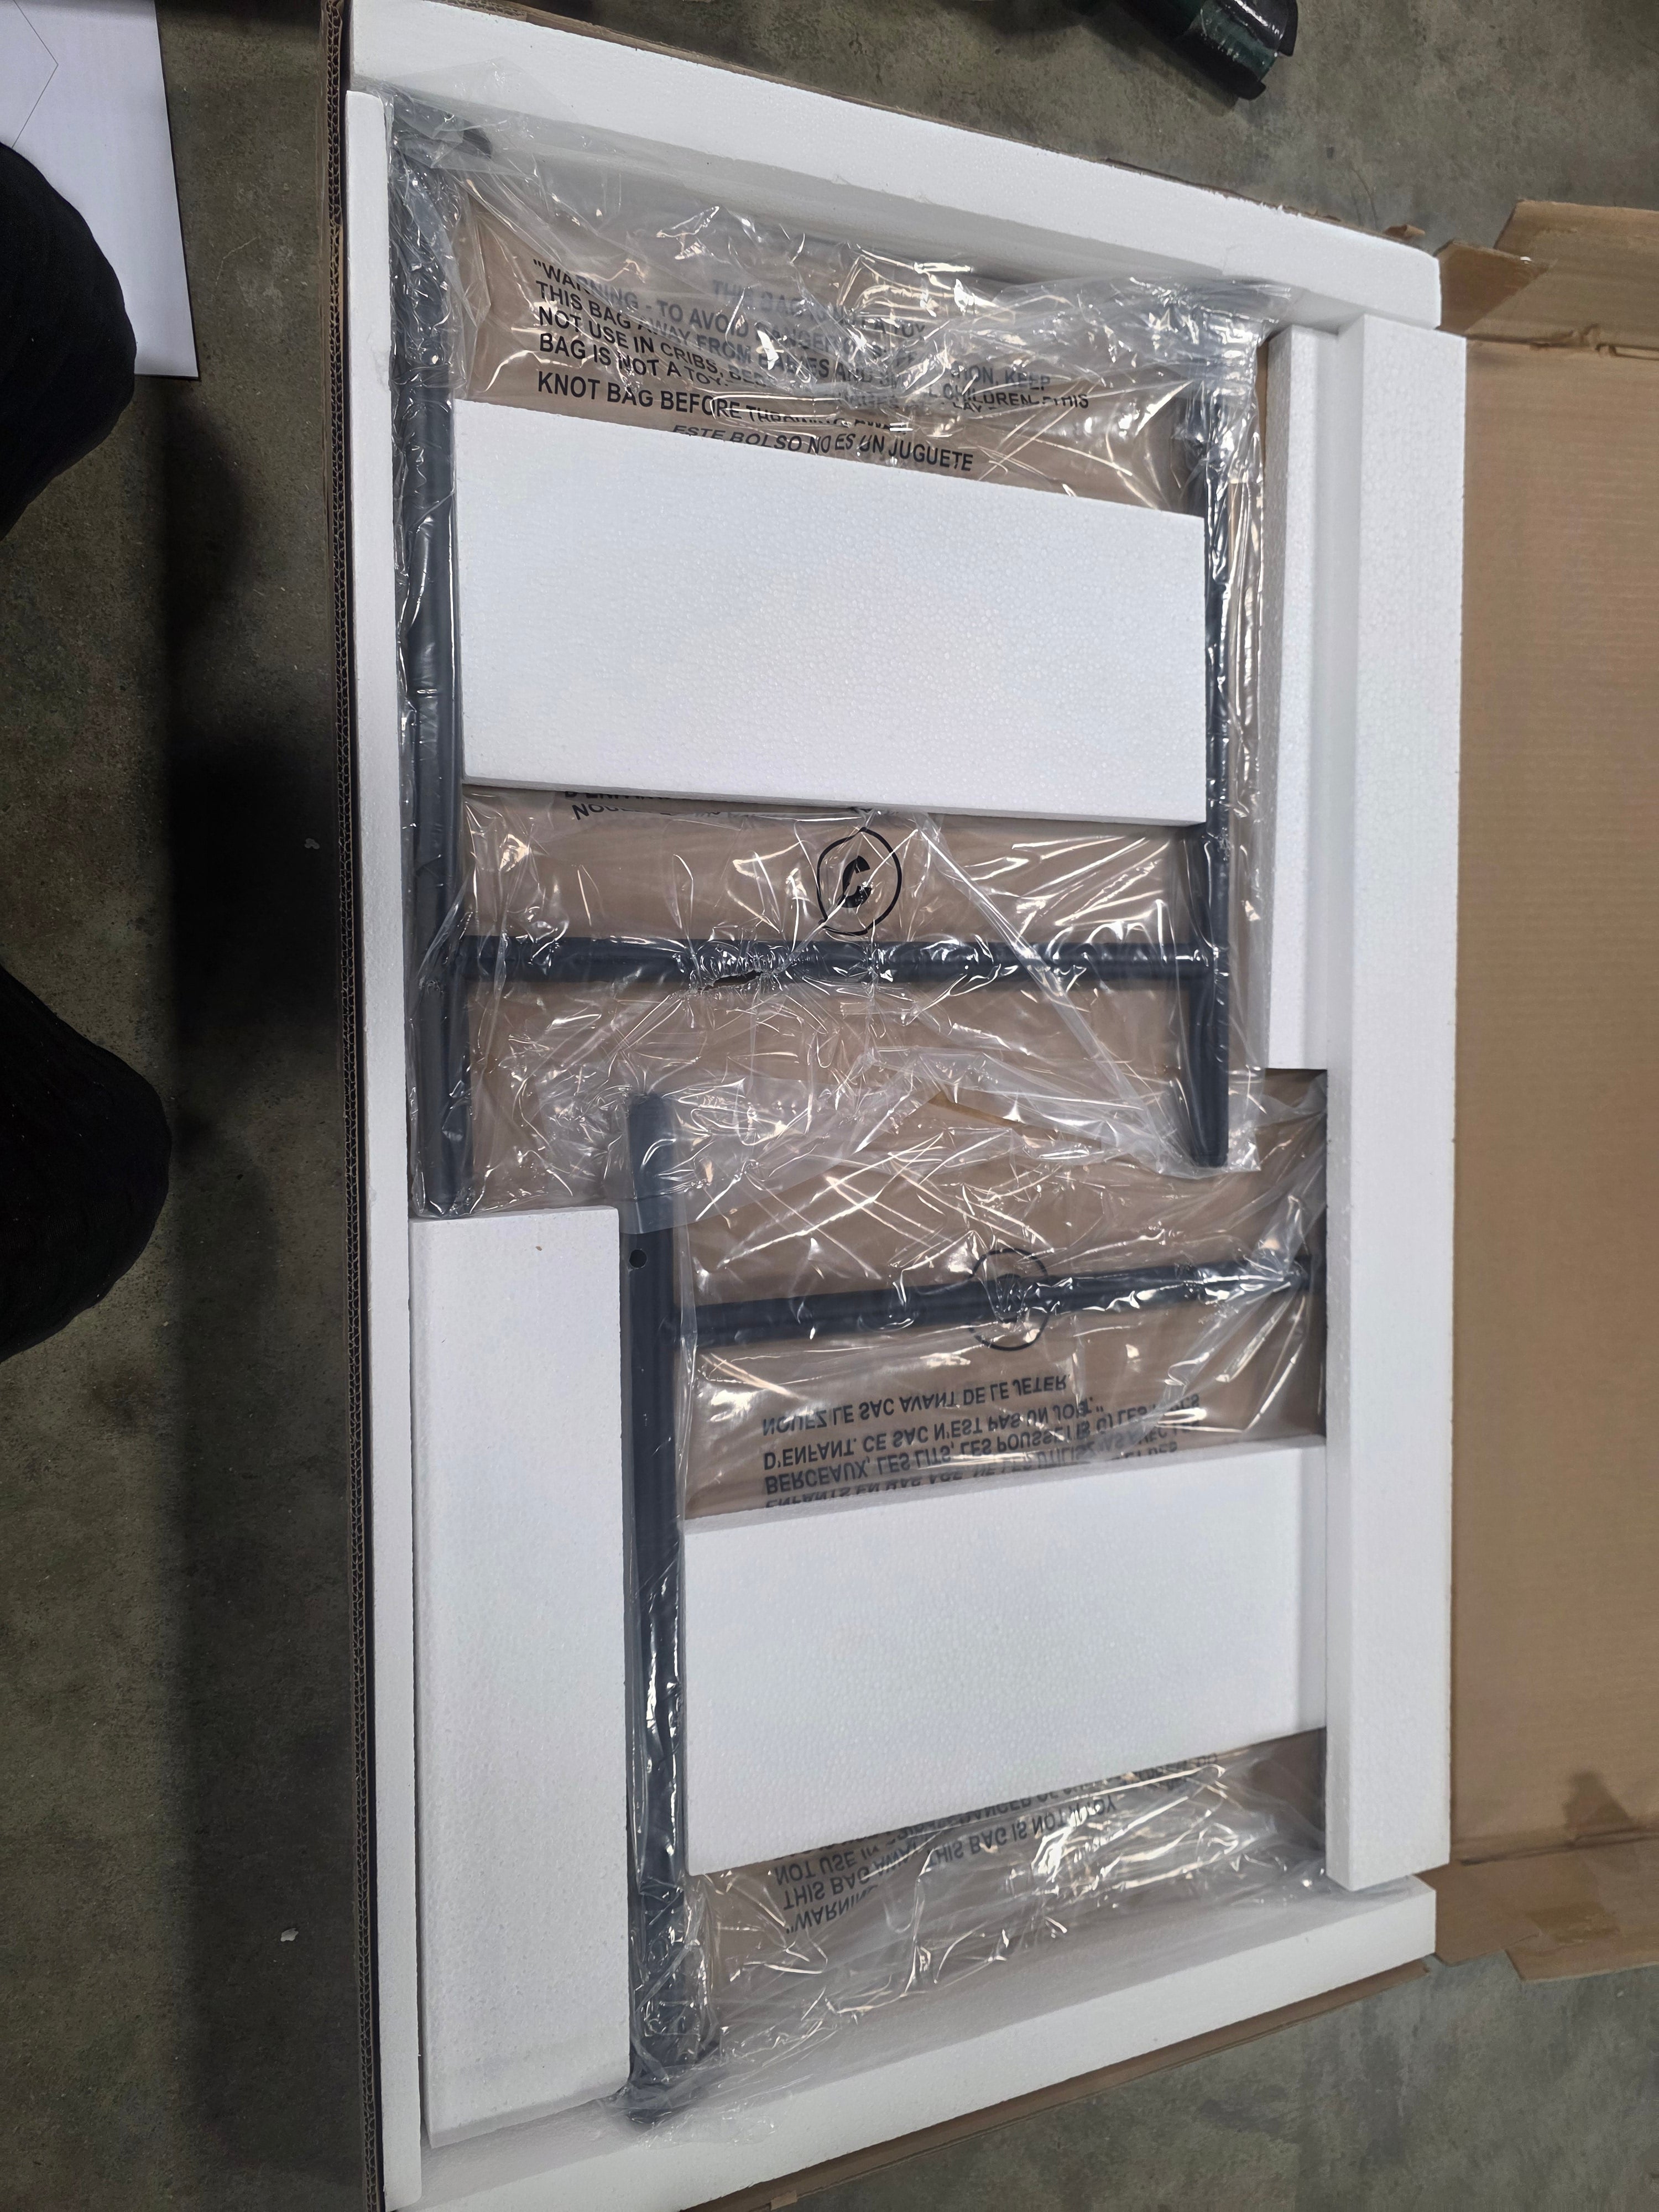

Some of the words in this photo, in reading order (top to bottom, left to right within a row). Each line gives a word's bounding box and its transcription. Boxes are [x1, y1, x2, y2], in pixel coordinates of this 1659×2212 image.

[536, 280, 583, 311] THIS
[588, 300, 631, 329] BAG
[696, 333, 751, 364] FROM
[539, 306, 582, 332] NOT
[589, 320, 629, 349] USE
[633, 336, 655, 353] IN
[656, 299, 684, 323] TO
[540, 332, 586, 360] BAG
[593, 344, 612, 366] IS
[618, 351, 659, 377] NOT
[666, 361, 681, 377] A
[538, 371, 601, 400] KNOT
[607, 382, 654, 408] BAG
[660, 390, 743, 420] BEFORE
[672, 424, 726, 440] ESTE
[729, 431, 802, 452] BOLSO
[807, 435, 831, 454] NO
[834, 433, 855, 451] ES
[859, 434, 885, 454] UN
[888, 437, 973, 472] JUGUETE
